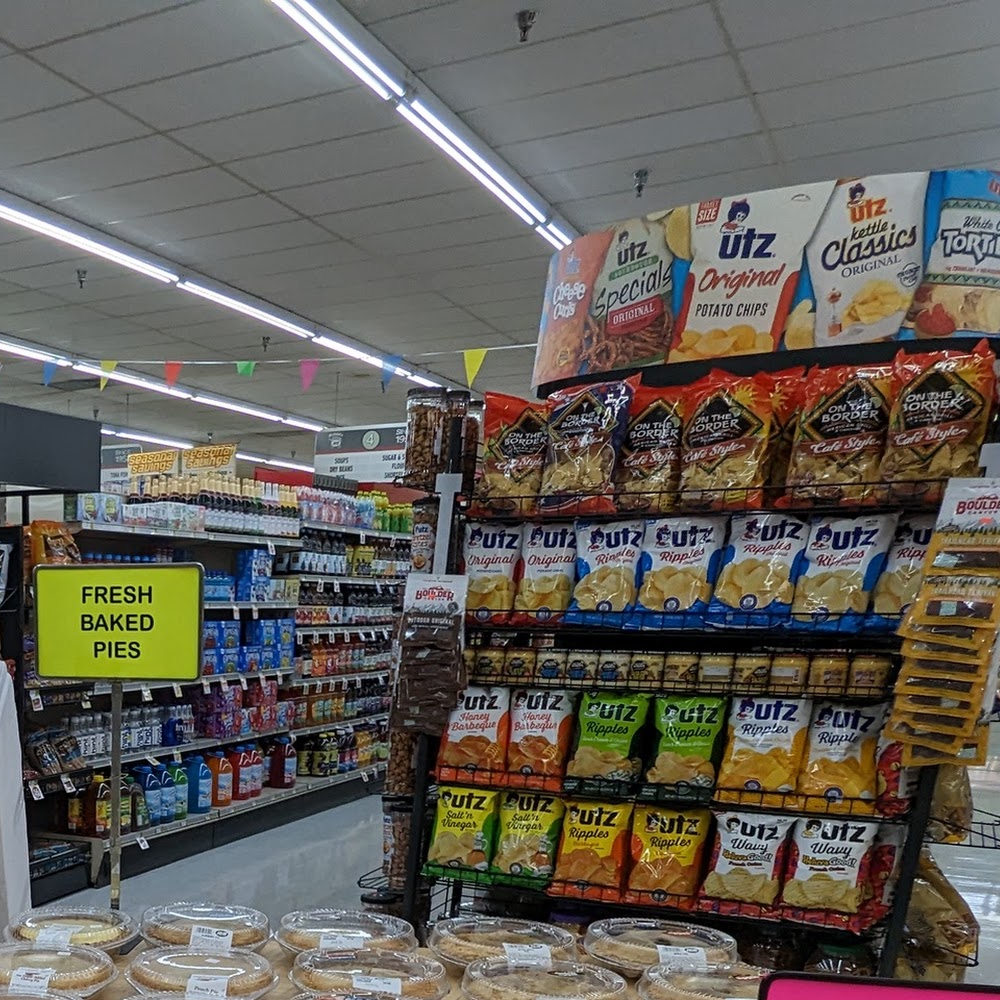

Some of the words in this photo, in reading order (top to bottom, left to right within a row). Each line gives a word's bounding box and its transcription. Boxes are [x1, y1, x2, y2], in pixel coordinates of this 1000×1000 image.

[697, 207, 718, 222] SIZE
[850, 198, 887, 224] utz
[850, 221, 889, 241] kettle
[963, 216, 992, 229] White
[719, 228, 776, 260] utz
[821, 224, 917, 271] Classics
[617, 240, 648, 266] utz
[841, 253, 901, 278] ORIGINAL
[592, 260, 672, 318] Specials
[698, 262, 786, 300] Original
[612, 303, 656, 325] ORIGINAL
[695, 302, 732, 317] POTATO
[735, 302, 768, 317] CHIPS
[905, 392, 926, 402] ON
[929, 390, 953, 400] THE
[822, 410, 879, 423] BORDER
[828, 404, 846, 414] ON
[849, 402, 873, 411] THE
[561, 417, 600, 428] BORDER
[634, 422, 649, 431] ON
[652, 421, 673, 430] THE
[710, 413, 732, 423] THE
[629, 427, 679, 439] BORDER
[504, 437, 548, 447] BORDER
[131, 461, 172, 474] savings
[186, 455, 230, 469] savings
[605, 526, 643, 549] utz
[671, 525, 714, 547] utz
[760, 519, 804, 542] utz
[832, 525, 879, 550] utz
[482, 530, 520, 550] utz
[743, 541, 792, 556] Ripples
[527, 553, 576, 571] Original
[660, 547, 705, 566] Ripples
[81, 585, 153, 604] FRESH
[81, 614, 154, 632] BAKED
[94, 641, 141, 658] PIES
[464, 694, 498, 711] utz
[527, 693, 561, 711] utz
[459, 712, 490, 724] Honey
[522, 712, 552, 724] Honey
[599, 703, 638, 722] utz
[679, 704, 718, 724] utz
[755, 700, 799, 722] utz
[450, 720, 497, 732] Barbeque
[514, 720, 557, 731] Barbeque
[586, 721, 629, 736] Ripples
[741, 722, 788, 737] Ripples
[832, 709, 876, 733] utz
[666, 726, 712, 741] Ripples
[451, 793, 487, 810] utz
[518, 794, 553, 813] utz
[441, 819, 478, 831] Vinegar
[579, 807, 617, 827] utz
[659, 814, 701, 835] utz
[506, 821, 544, 832] Vinegar
[568, 827, 609, 840] Ripples
[741, 821, 779, 841] utz
[821, 822, 867, 843] utz
[650, 836, 691, 849] Ripples
[731, 838, 769, 854] Wavy
[811, 842, 853, 858] Wavy
